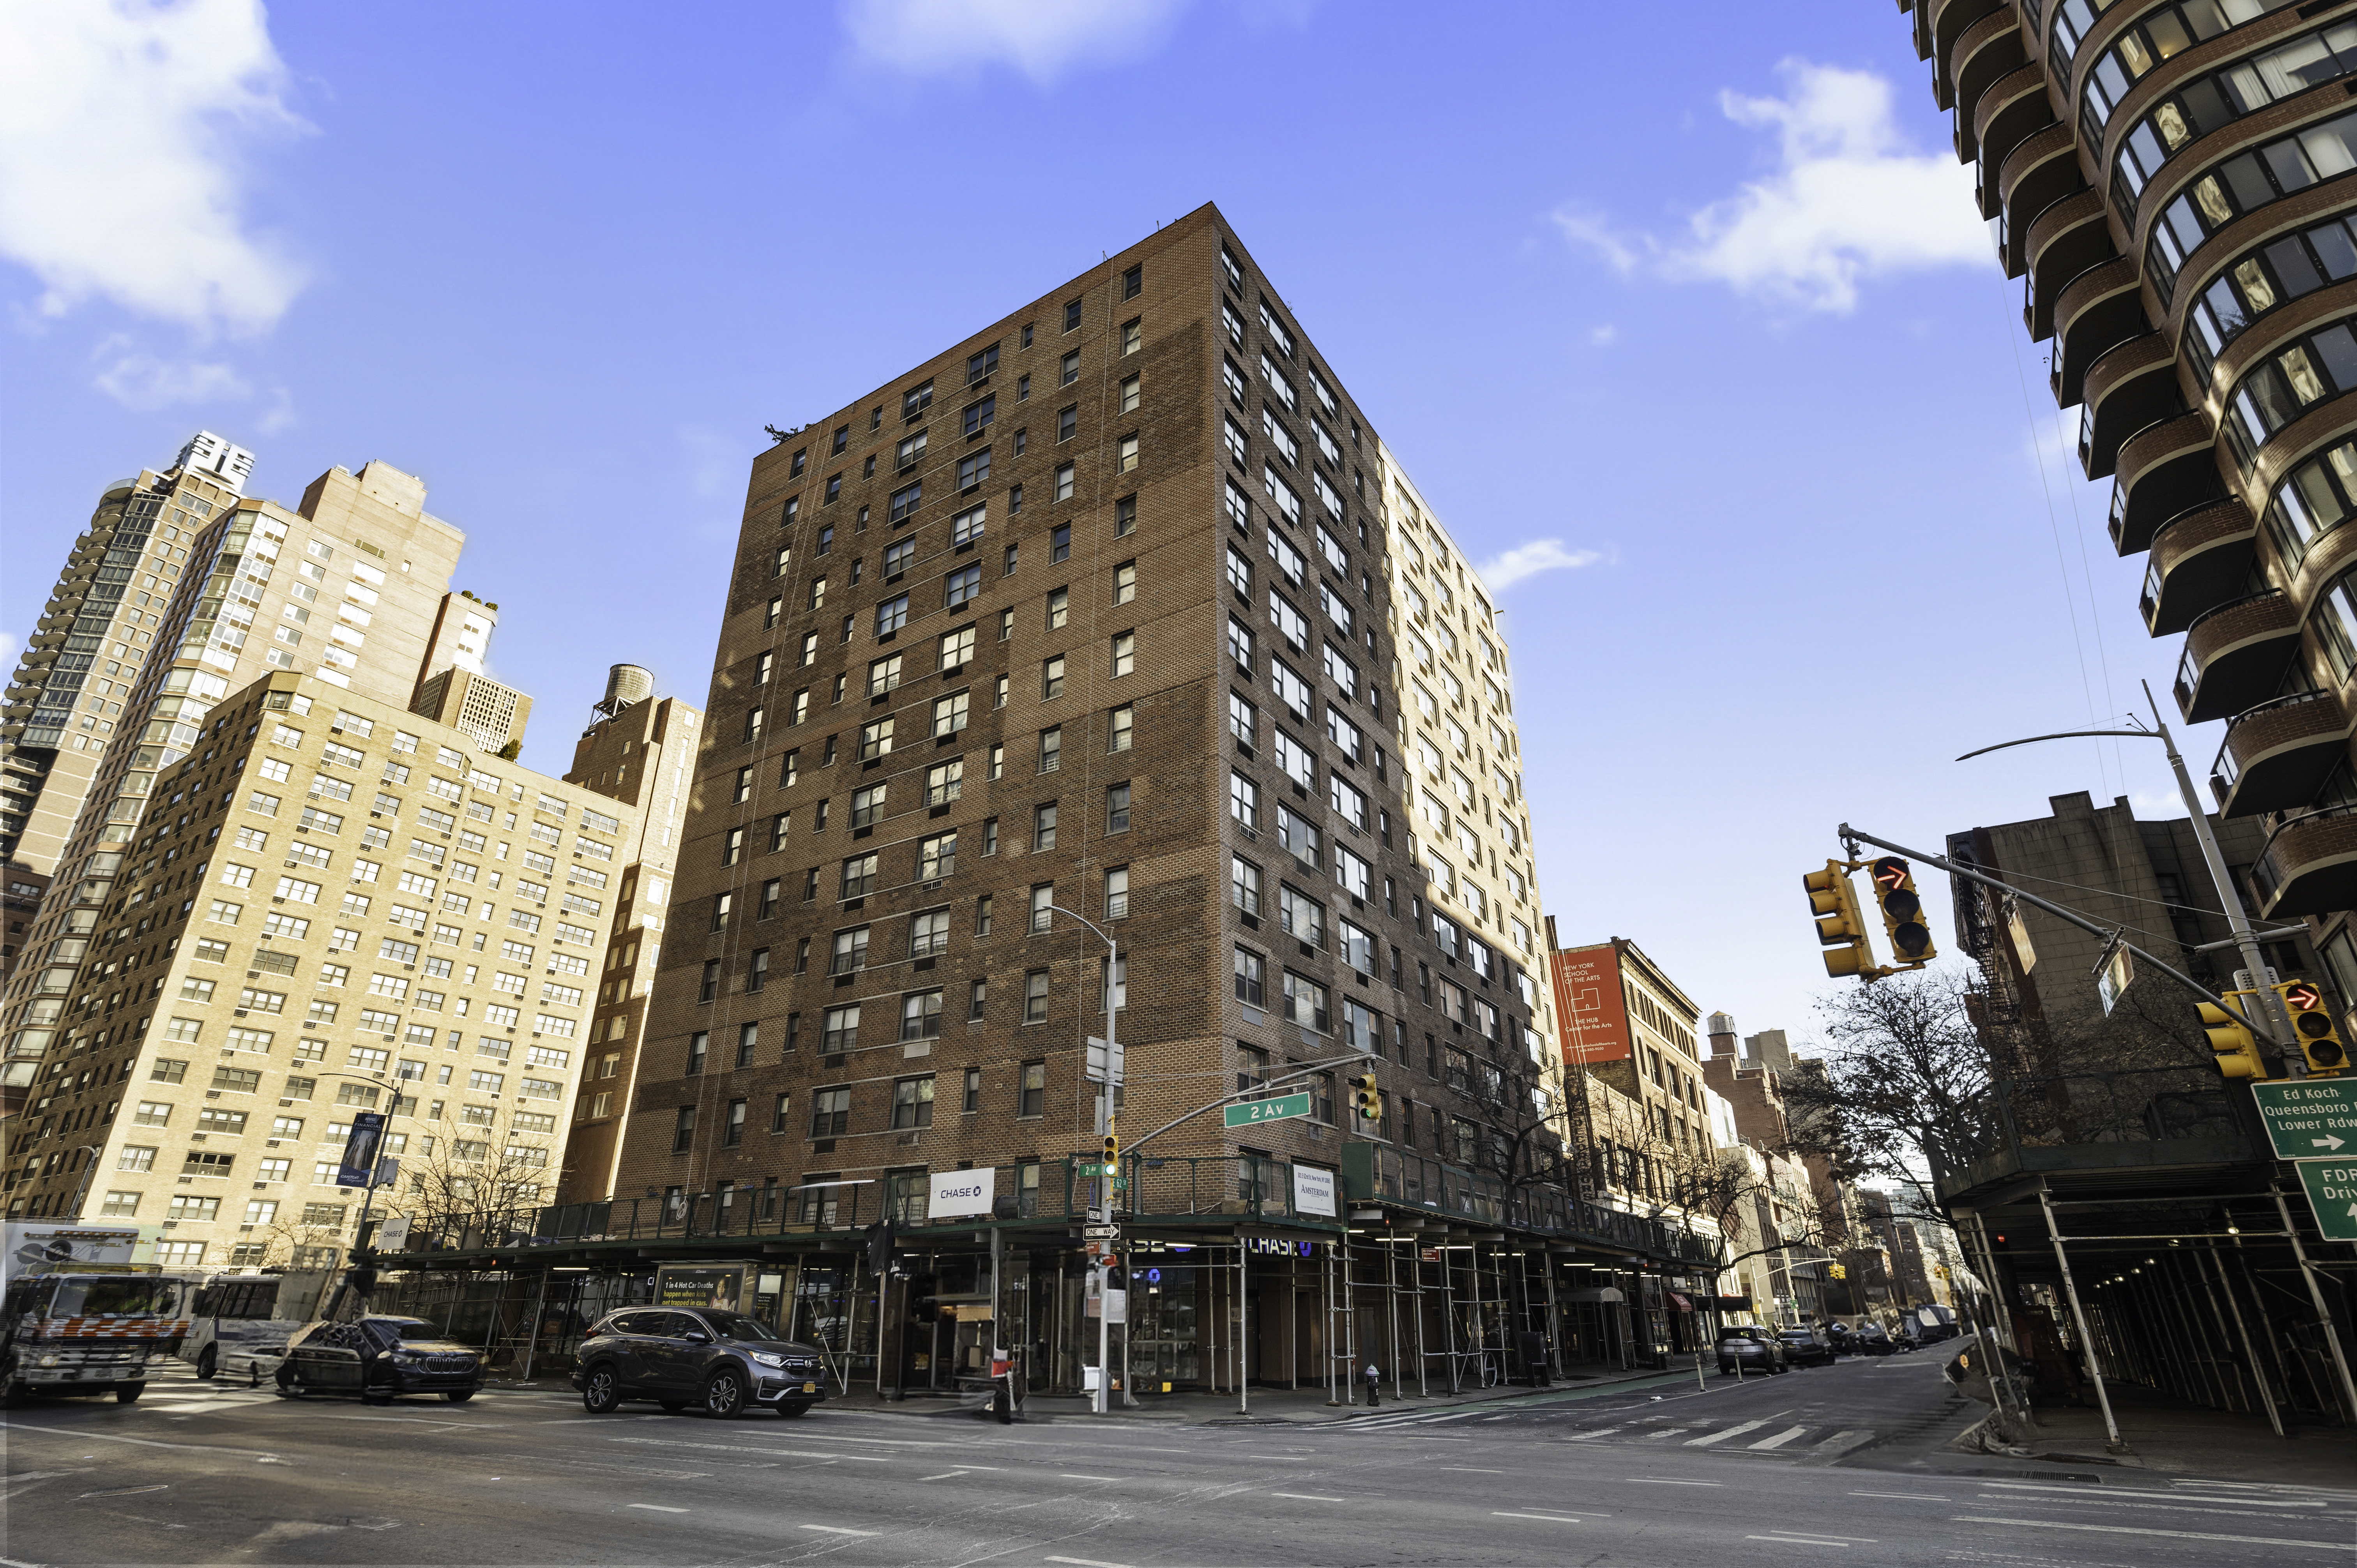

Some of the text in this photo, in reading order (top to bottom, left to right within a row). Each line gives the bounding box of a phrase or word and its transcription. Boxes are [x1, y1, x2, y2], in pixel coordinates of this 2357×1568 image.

[2283, 1087, 2339, 1100] Ed Koch
[1251, 1104, 1283, 1119] 2 Av
[2265, 1103, 2349, 1116] Queensboro
[2277, 1120, 2321, 1130] Lower
[1085, 1166, 1089, 1175] 2
[1117, 1178, 1122, 1188] 62
[941, 1188, 972, 1198] CHASE
[664, 1290, 681, 1298] happen
